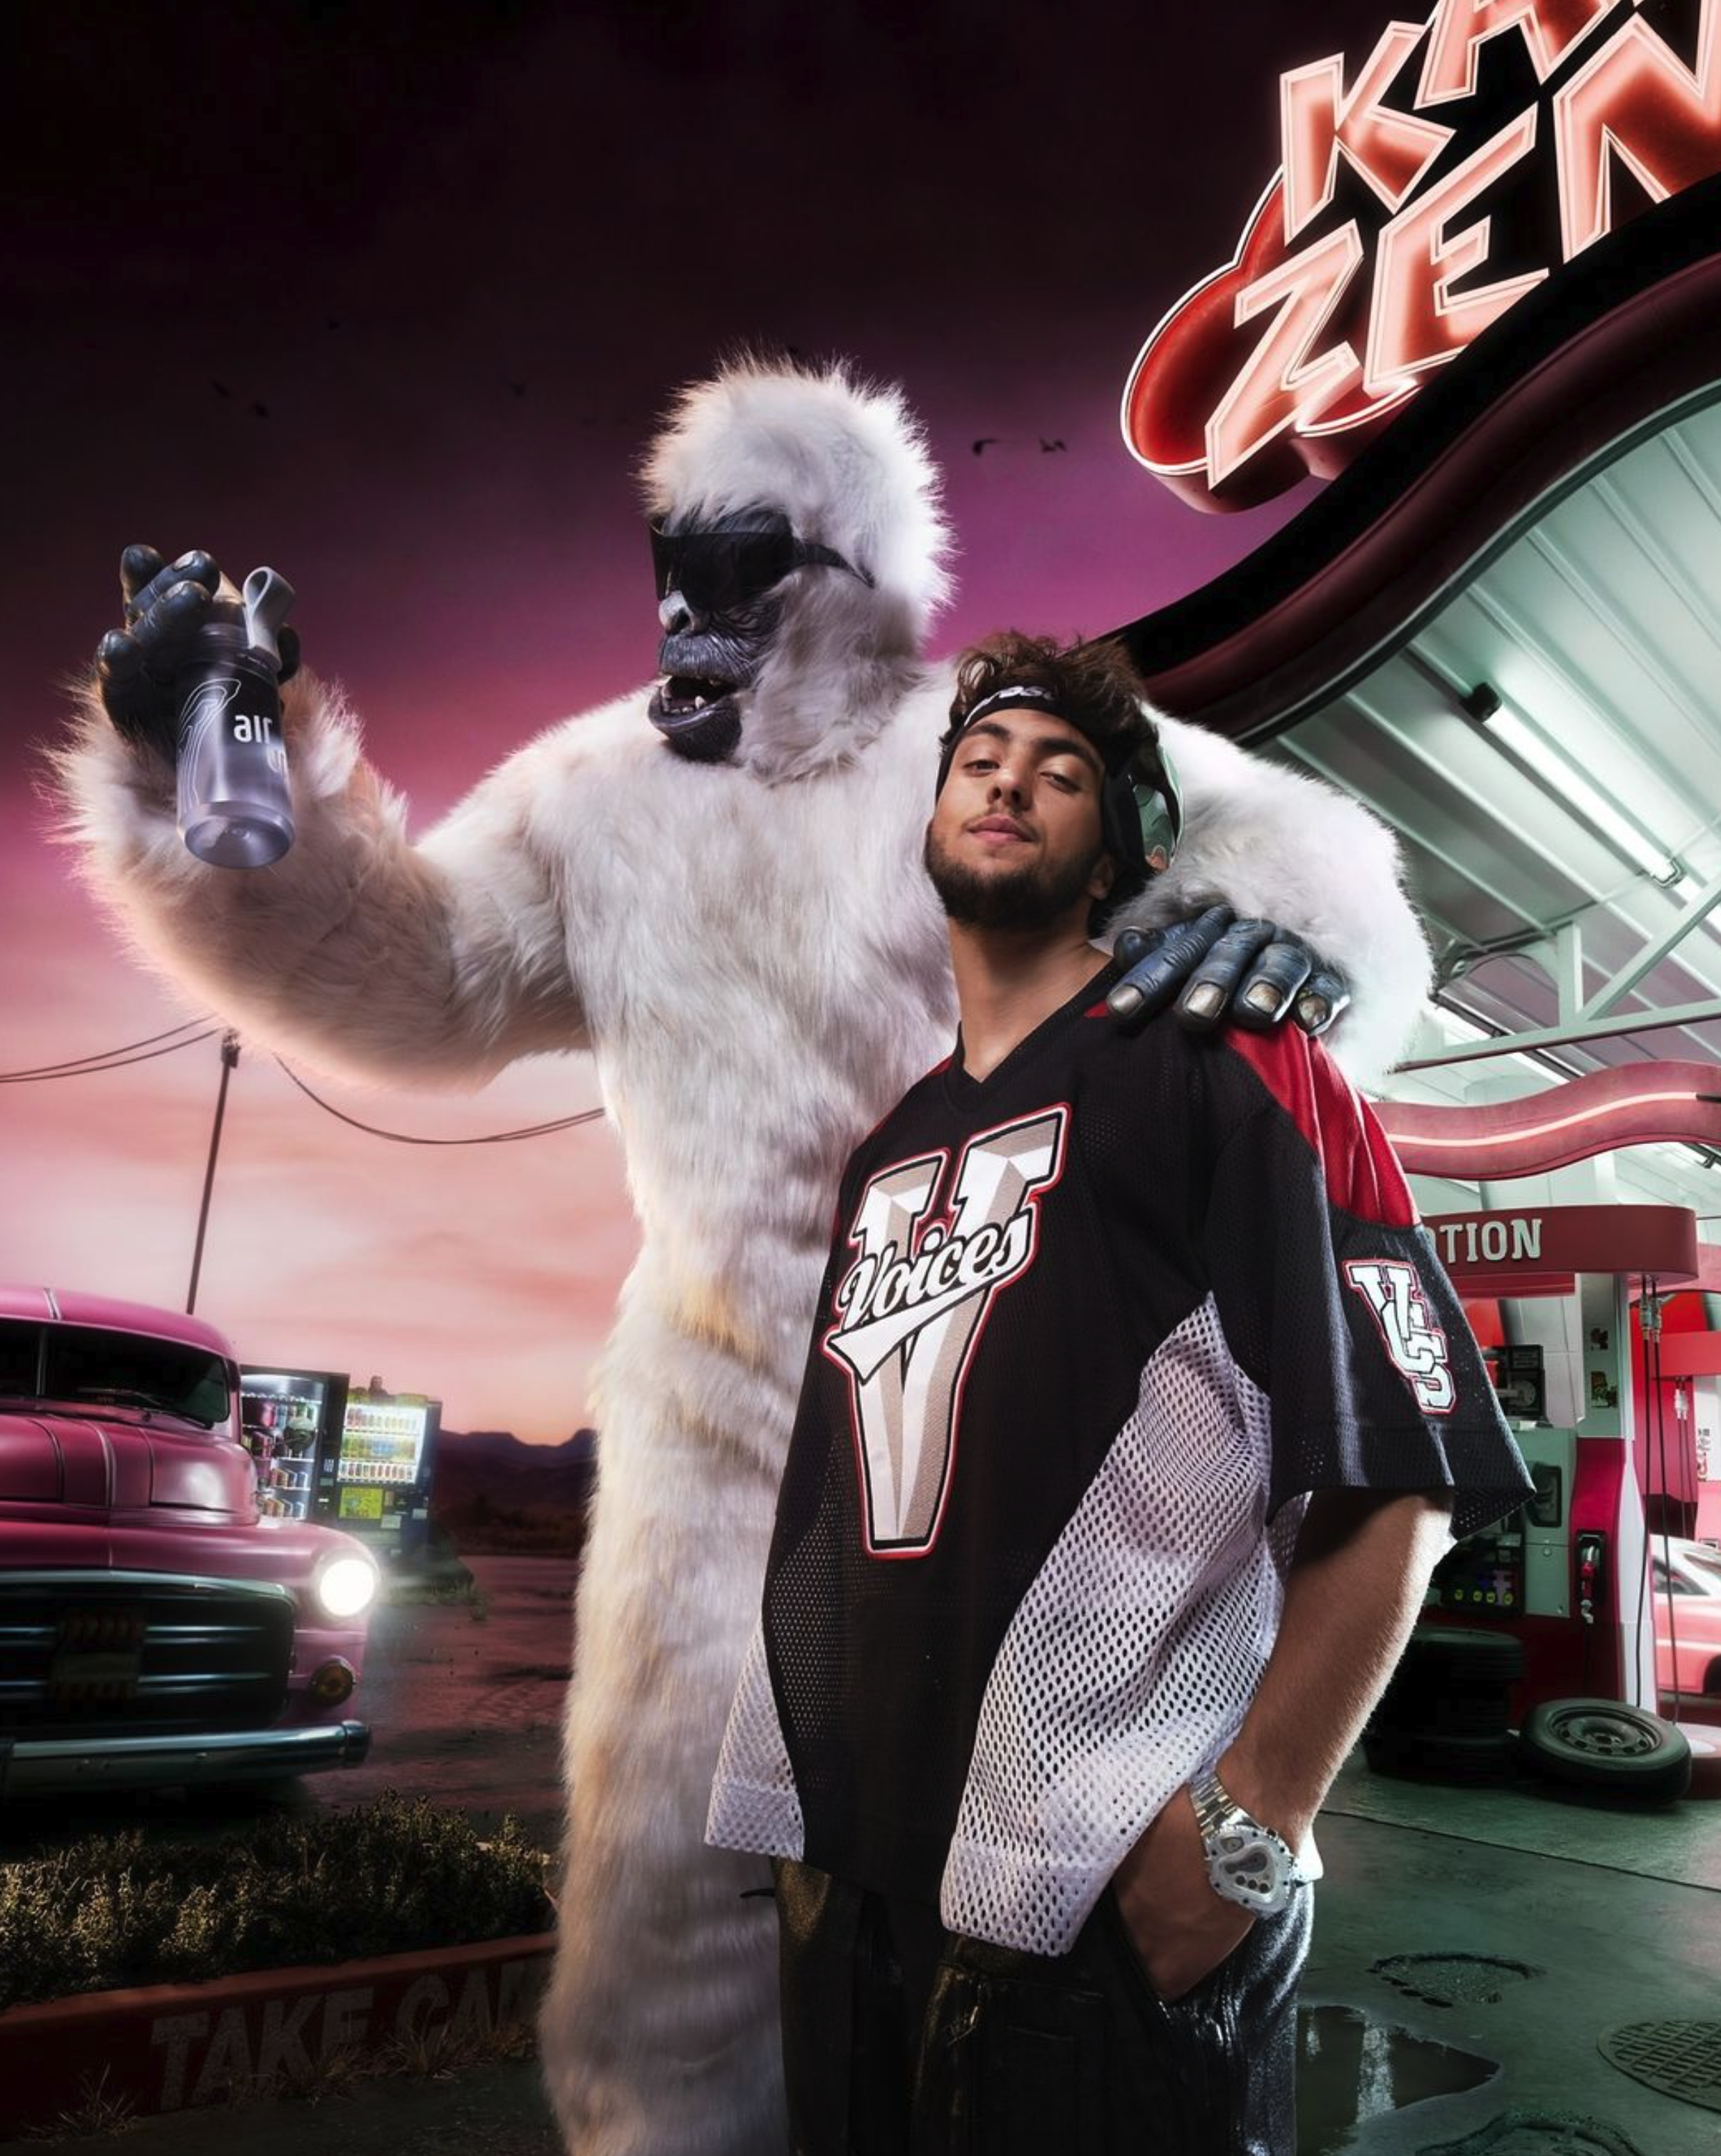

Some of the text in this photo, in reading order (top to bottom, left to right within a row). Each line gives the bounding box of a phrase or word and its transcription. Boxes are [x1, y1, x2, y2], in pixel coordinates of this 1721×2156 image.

[1206, 0, 1721, 490] ZEN
[837, 1212, 1032, 1331] Voices
[151, 1984, 375, 2114] TAKE
